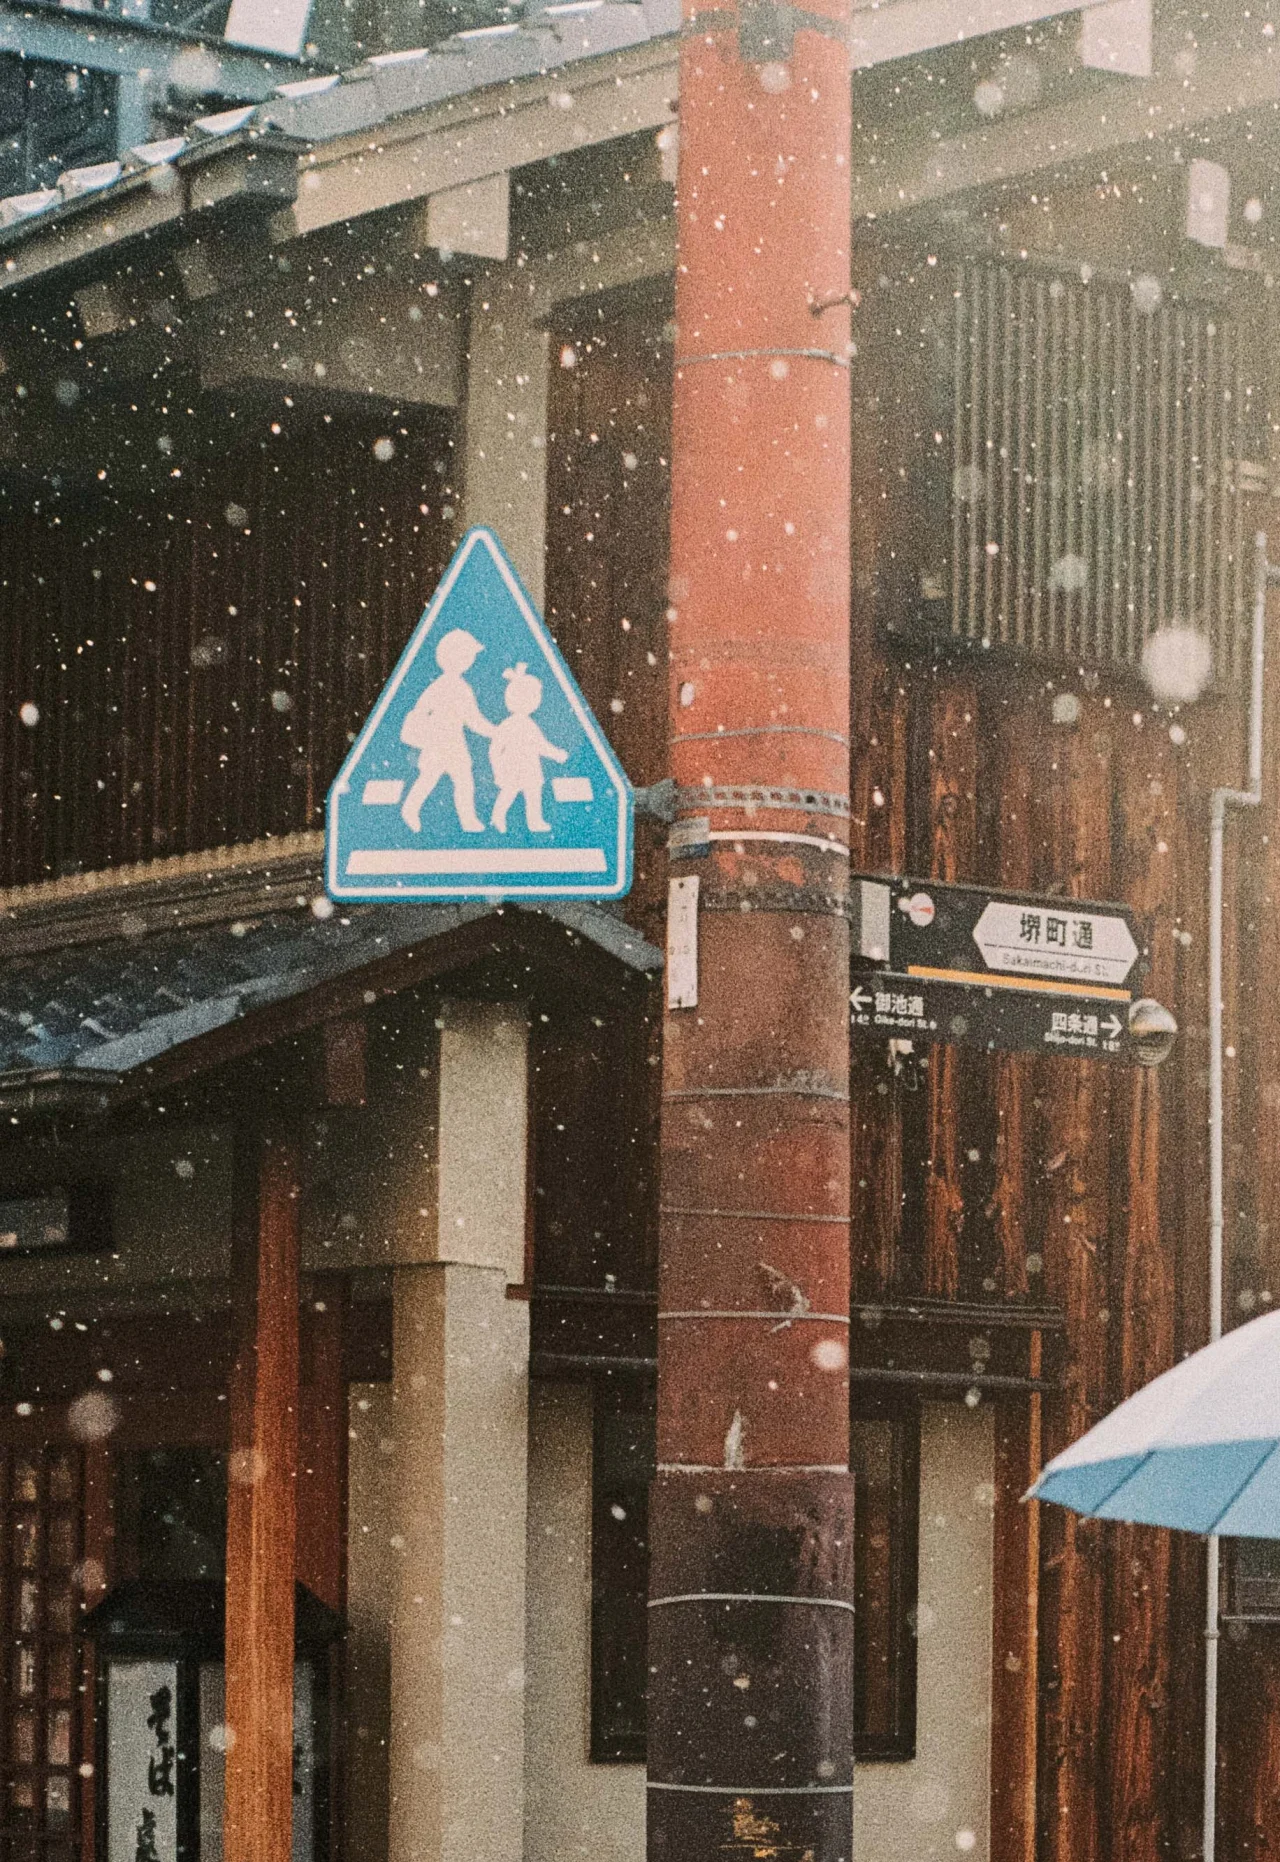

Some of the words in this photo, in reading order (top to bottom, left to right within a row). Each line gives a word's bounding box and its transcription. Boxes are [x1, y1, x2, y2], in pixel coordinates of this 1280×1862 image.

[1020, 913, 1093, 950] 堺町通
[875, 992, 924, 1016] 御池通
[1052, 1012, 1098, 1035] 四条通
